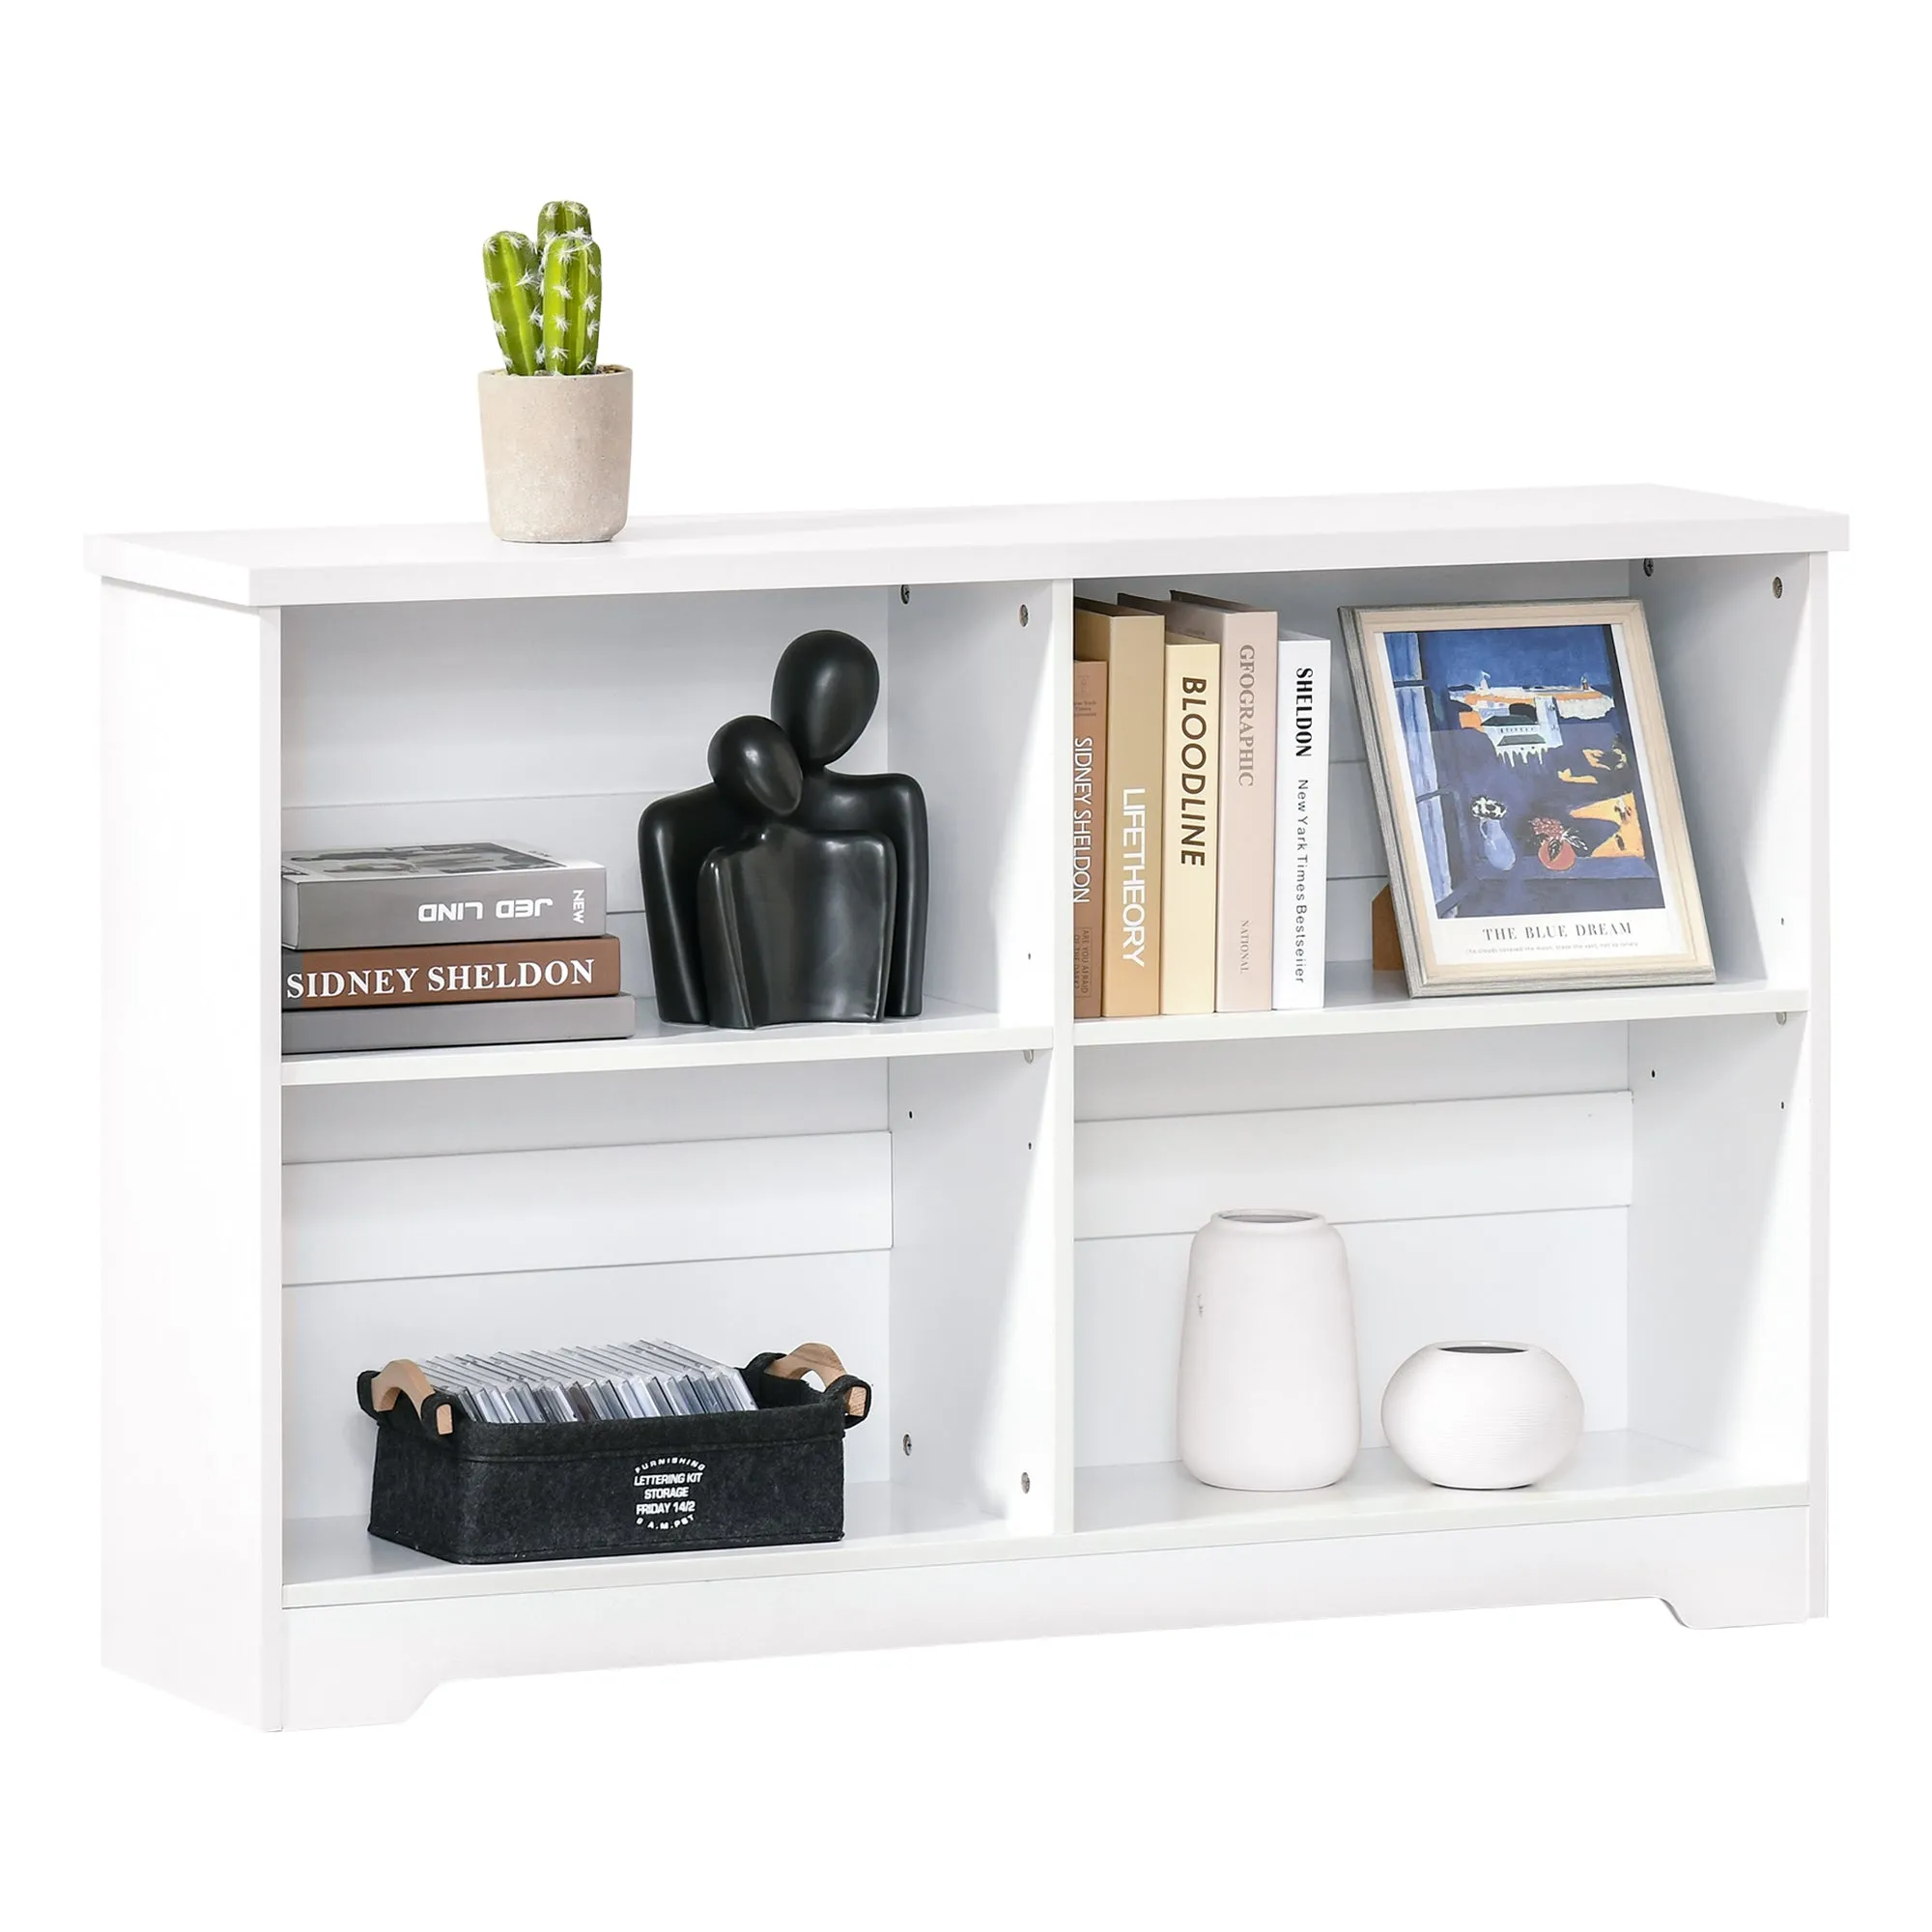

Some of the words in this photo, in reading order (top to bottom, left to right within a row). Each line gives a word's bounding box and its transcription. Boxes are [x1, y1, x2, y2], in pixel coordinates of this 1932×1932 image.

[1294, 668, 1314, 757] SHELDON
[1074, 737, 1093, 805] SIDNEY
[1180, 676, 1208, 867] BLOODLINE
[1297, 779, 1309, 812] New
[1073, 810, 1092, 903] SHELDON
[1122, 788, 1146, 967] LIFETHEORY
[1295, 854, 1308, 901] Times
[418, 901, 484, 923] LIND
[496, 897, 554, 919] JED
[573, 889, 585, 924] NEW
[1239, 920, 1250, 974] NATIONAL
[1482, 927, 1518, 941] THE
[1524, 924, 1568, 939] BLUE
[1575, 922, 1632, 937] DREAM
[287, 966, 419, 999] SIDNEY
[428, 958, 595, 992] SHELDON
[634, 1457, 706, 1473] FURNISHING
[634, 1473, 686, 1487] LETTERING
[686, 1472, 703, 1483] KIT
[636, 1502, 671, 1516] FRIDAY
[672, 1500, 696, 1513] 14/2
[643, 1487, 690, 1500] STORAGE
